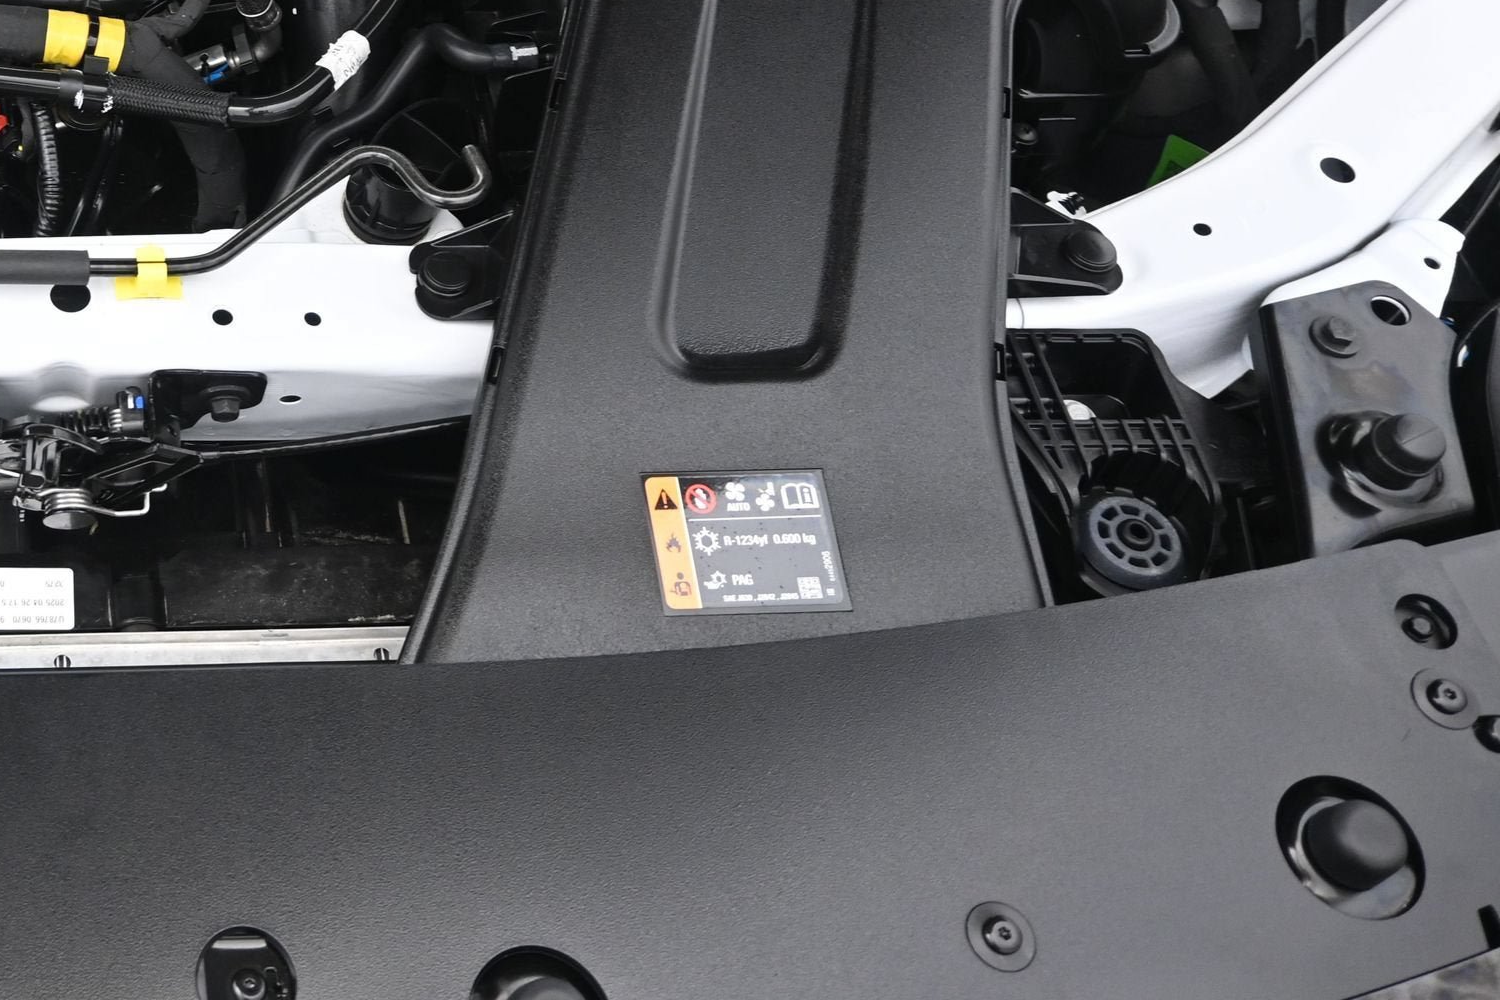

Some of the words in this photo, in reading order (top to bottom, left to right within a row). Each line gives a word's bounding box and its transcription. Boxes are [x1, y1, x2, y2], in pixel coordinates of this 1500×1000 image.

[726, 502, 751, 512] AUTO
[802, 533, 817, 546] kg
[731, 574, 754, 586] PAG
